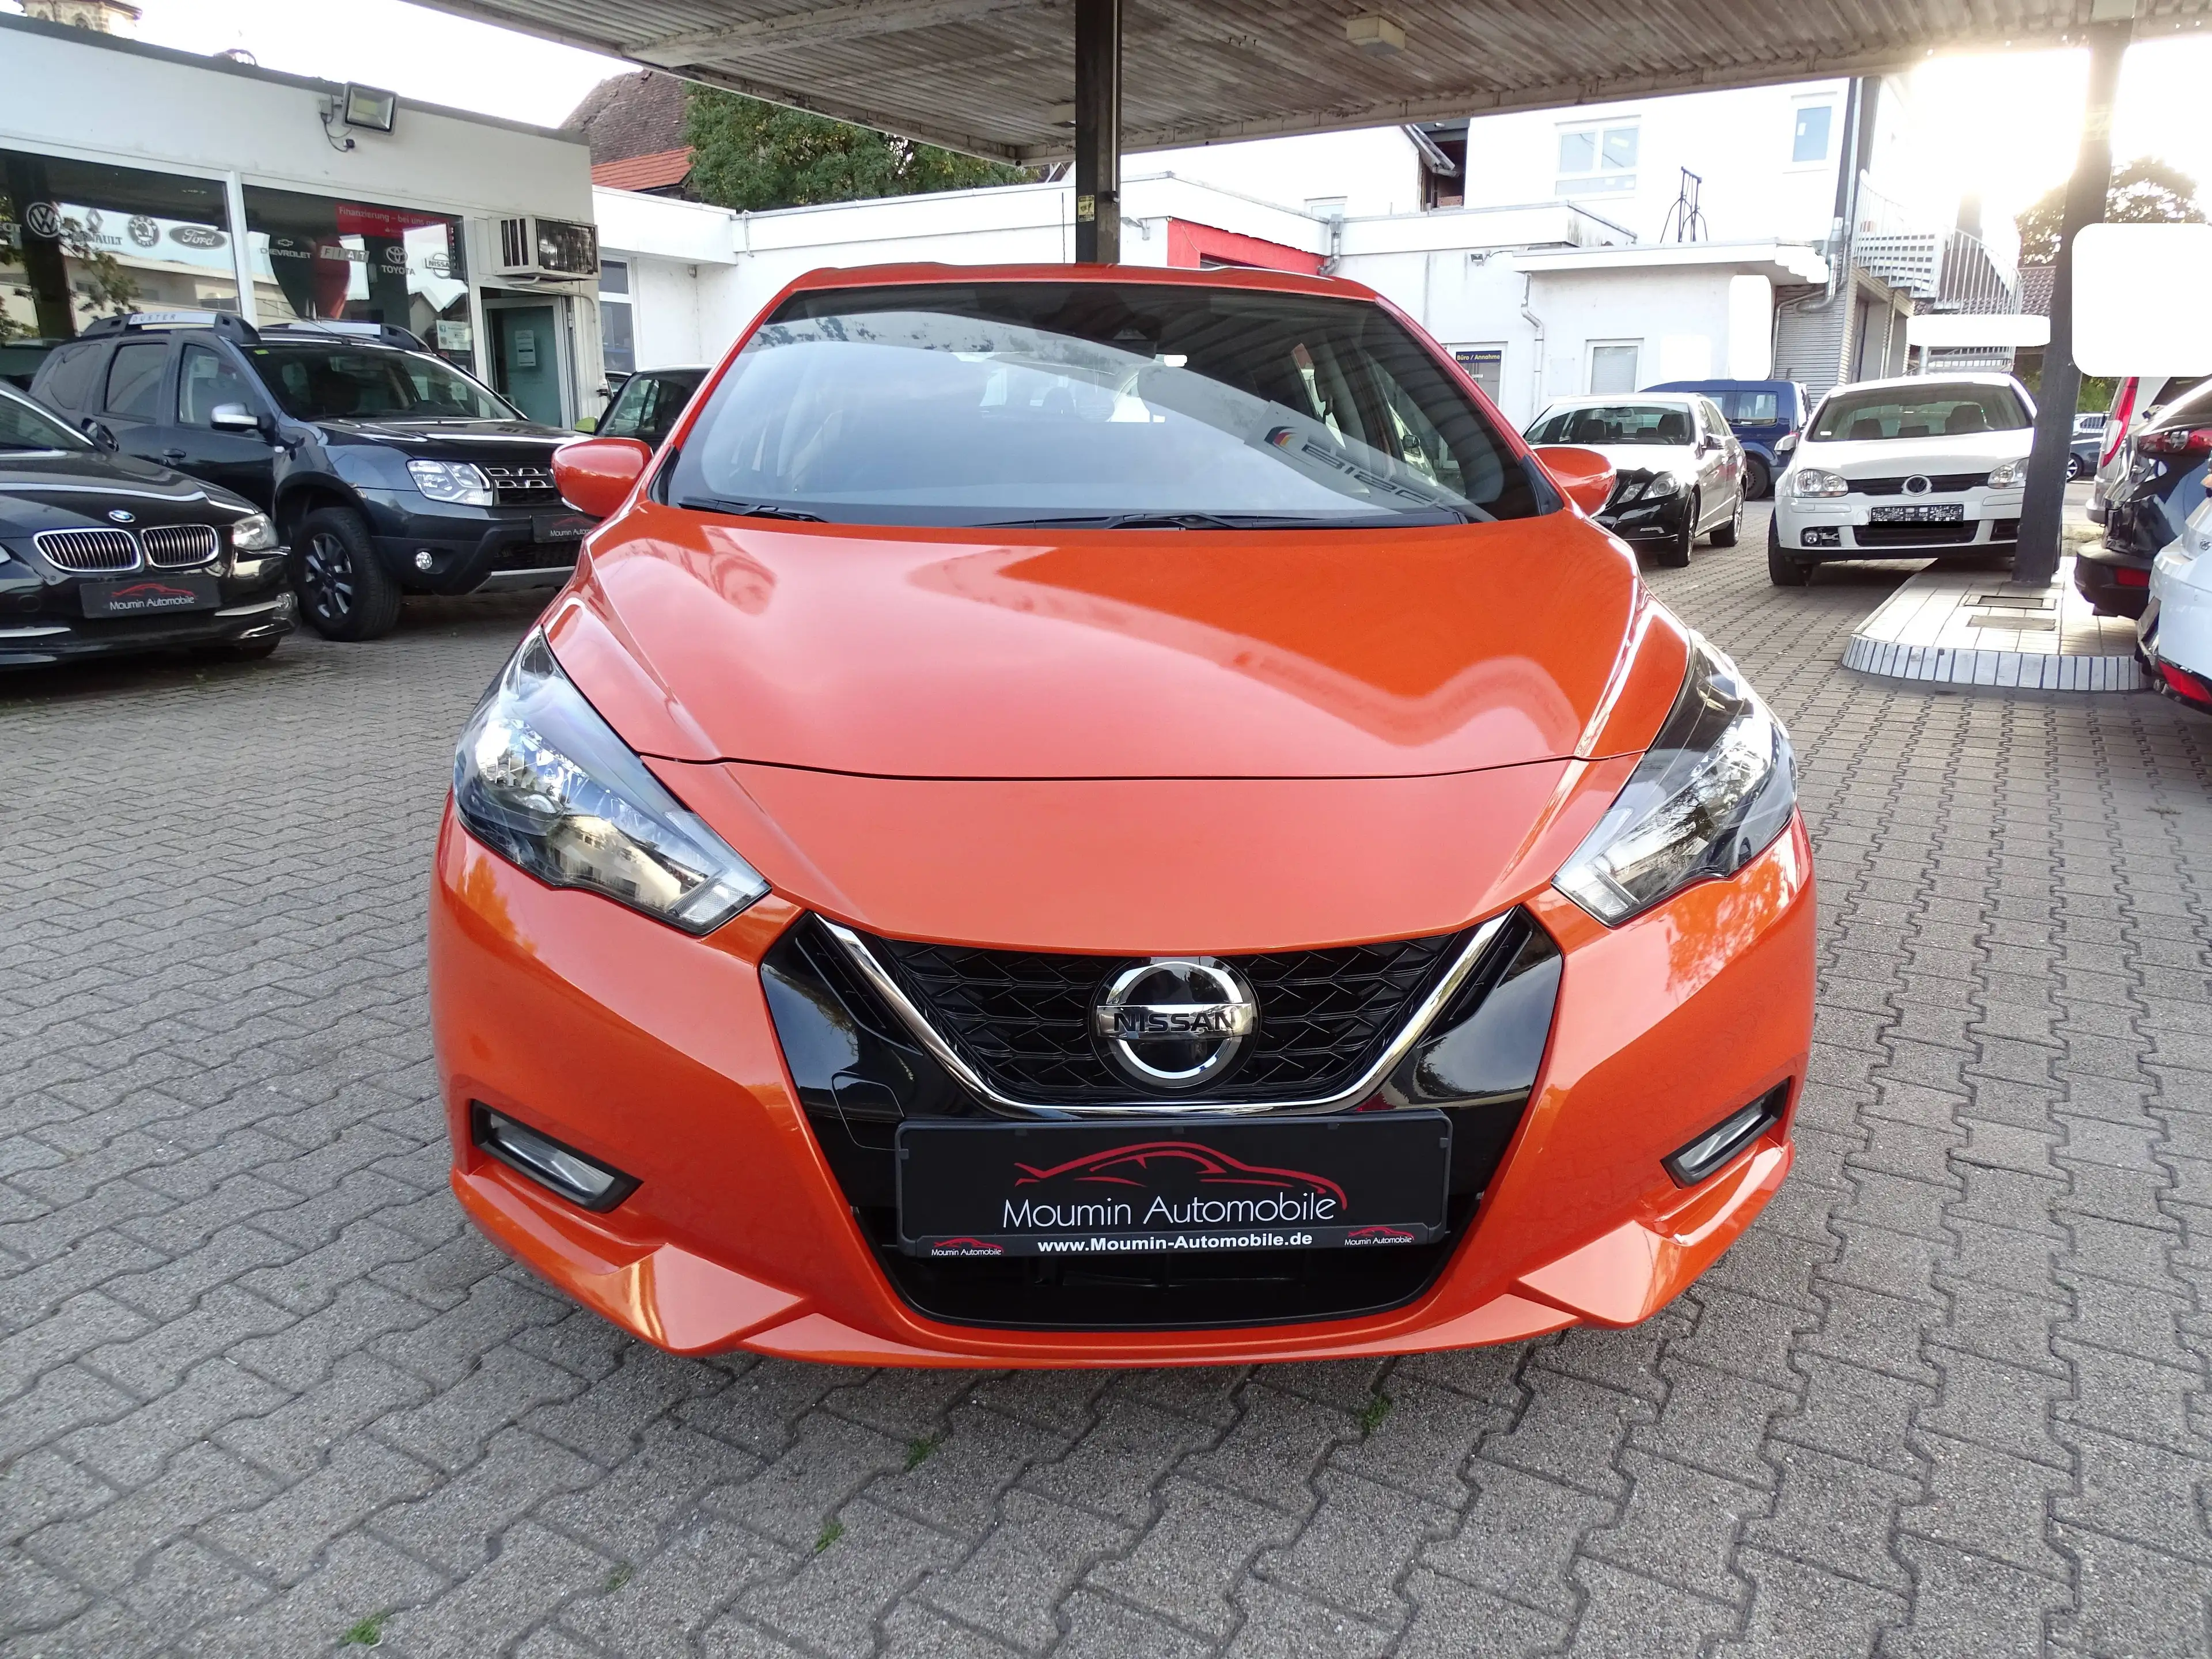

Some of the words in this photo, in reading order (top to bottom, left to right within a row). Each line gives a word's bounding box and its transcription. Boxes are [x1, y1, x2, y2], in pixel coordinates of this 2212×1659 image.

[339, 207, 390, 223] Finanzierung
[397, 214, 409, 224] bei
[182, 229, 215, 245] Ford
[260, 248, 312, 259] CHEVROLET
[323, 247, 367, 262] FIAT
[381, 264, 416, 275] TOYOTA
[132, 314, 176, 322] DUSTER
[109, 599, 145, 611] Moumin
[146, 596, 195, 608] Automobile
[1113, 1012, 1236, 1033] NISSAN
[1002, 1197, 1131, 1229] Moumin
[1142, 1191, 1336, 1225] Automobile
[1037, 1231, 1313, 1252] www.Moumin-Automobile.de
[1344, 1237, 1371, 1246] Moumin
[1372, 1236, 1412, 1244] Automobile
[931, 1248, 959, 1256] Moumin
[960, 1248, 1002, 1256] Automobile
